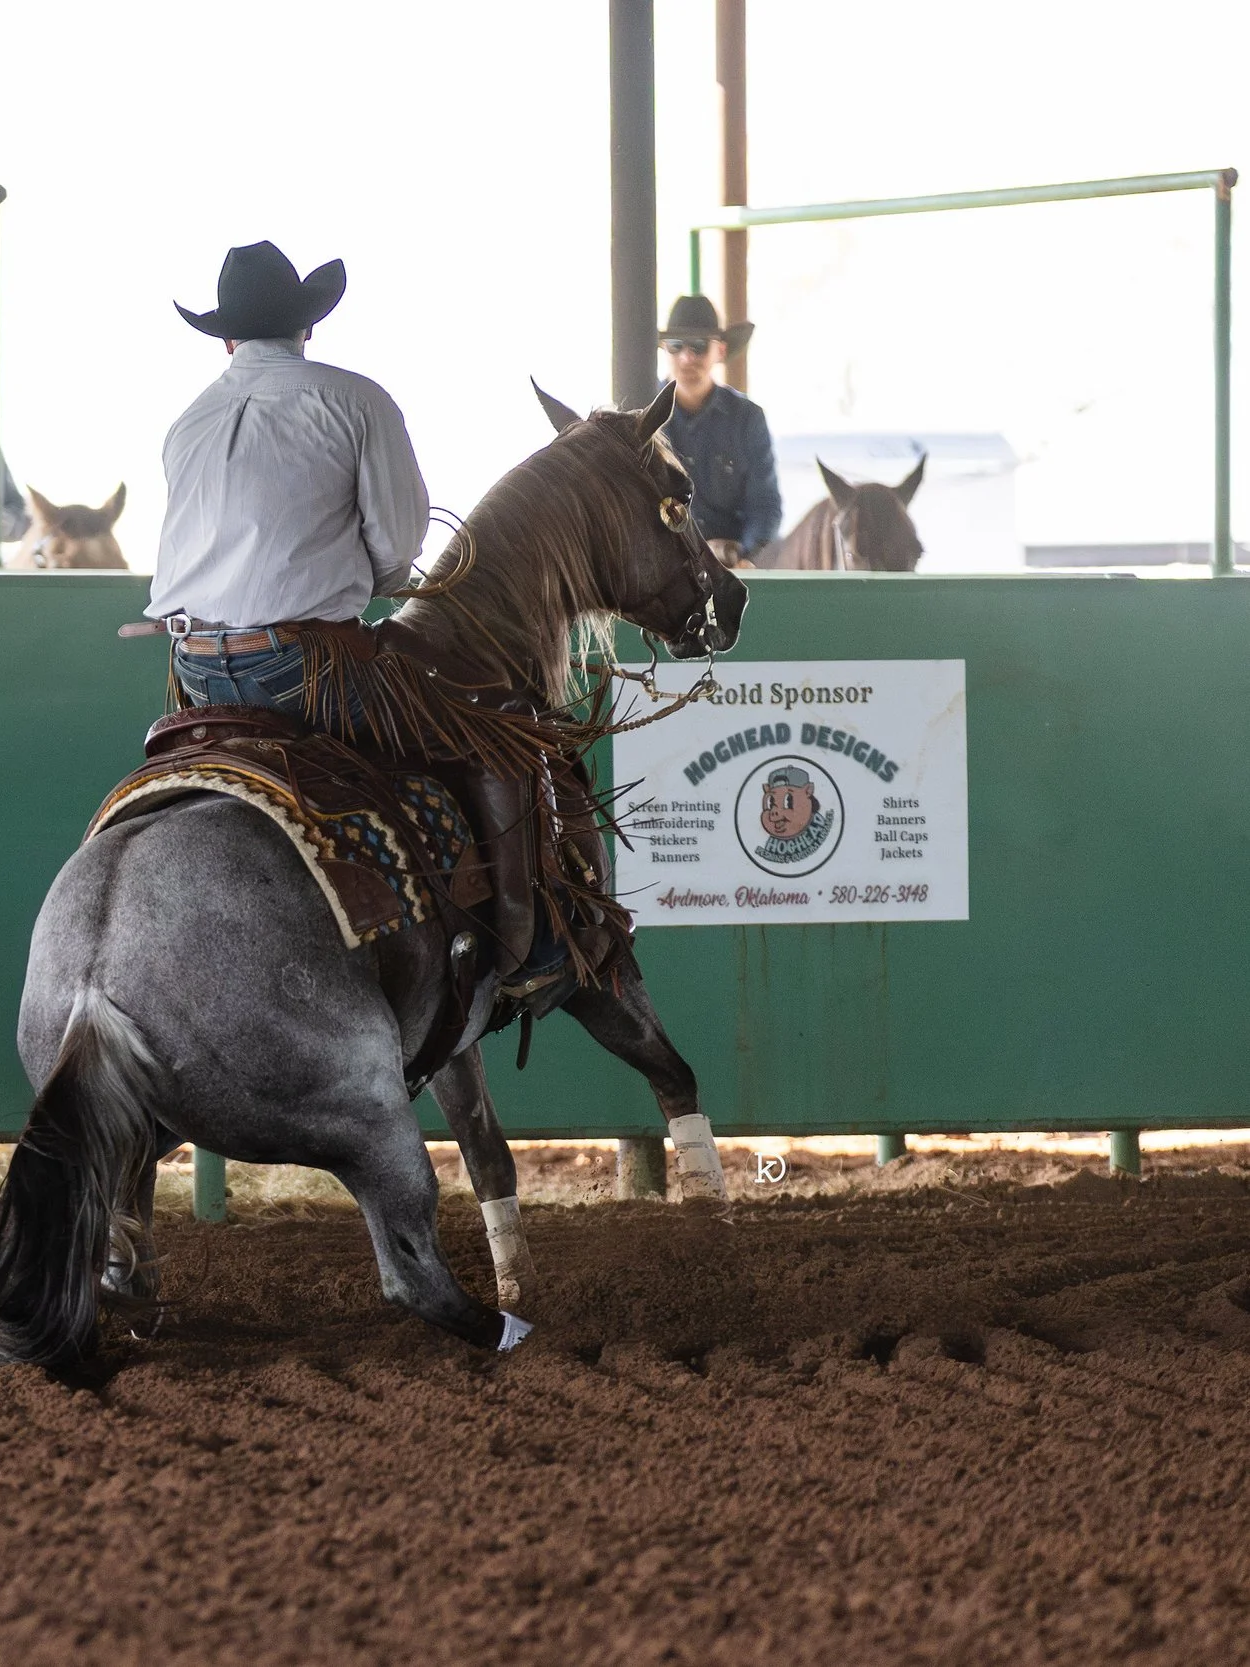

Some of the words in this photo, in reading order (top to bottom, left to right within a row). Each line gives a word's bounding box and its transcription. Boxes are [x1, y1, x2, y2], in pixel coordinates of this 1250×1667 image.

[770, 682, 874, 710] Sponsor
[683, 721, 792, 787] HOGHEAD
[800, 722, 900, 783] DESIGNS
[628, 800, 668, 813] Screen
[671, 800, 721, 815] Printing
[882, 796, 919, 809] Shirts
[632, 816, 715, 831] Embroidering
[877, 814, 926, 826] Banners
[650, 834, 698, 847] Stickers
[874, 830, 897, 843] Ball
[900, 831, 929, 845] Caps
[651, 851, 700, 864] Banners
[880, 847, 923, 860] Jackets
[656, 886, 730, 909] Ardmore,
[735, 886, 810, 908] Oklahoma
[829, 884, 929, 904] 580-226-3148
